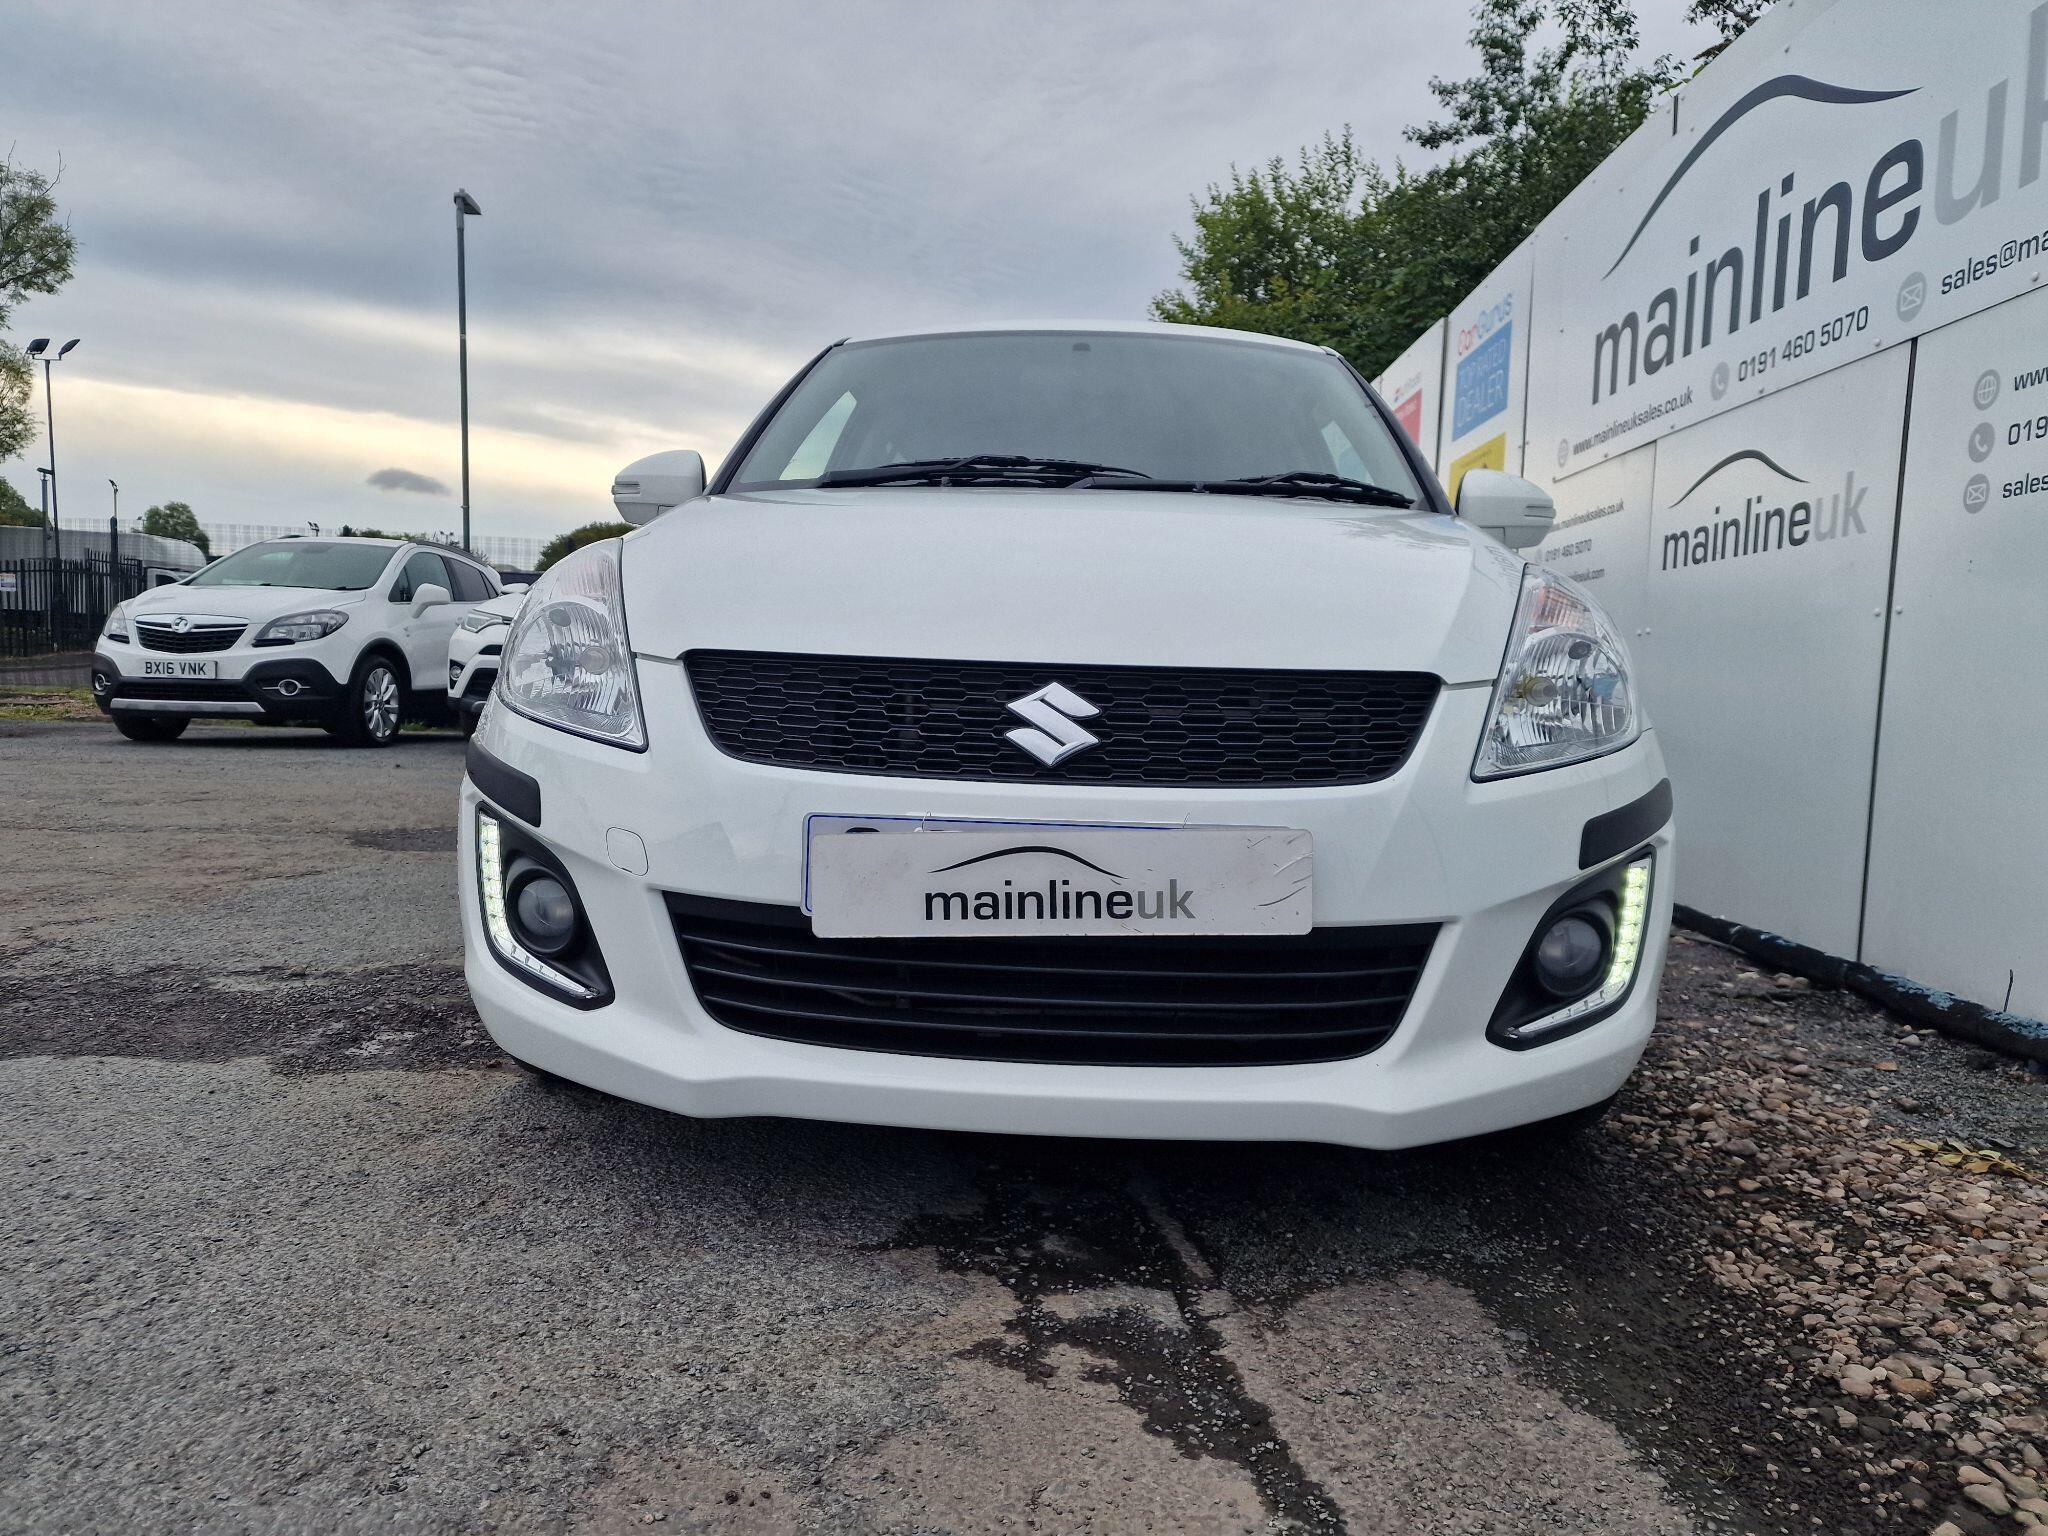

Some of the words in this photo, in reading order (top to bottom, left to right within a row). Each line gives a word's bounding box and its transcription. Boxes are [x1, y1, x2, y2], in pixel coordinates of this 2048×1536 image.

[1738, 346, 1776, 382] 0191
[1782, 329, 1815, 362] 460
[1820, 305, 1869, 347] 5070
[2014, 367, 2048, 391] ww
[1573, 385, 1693, 455] www.mainlineuksales.co.uk
[1662, 470, 1869, 571] mainlineuk
[145, 661, 174, 675] BX16
[179, 662, 206, 675] VNK
[924, 879, 1196, 921] mainlineuk
